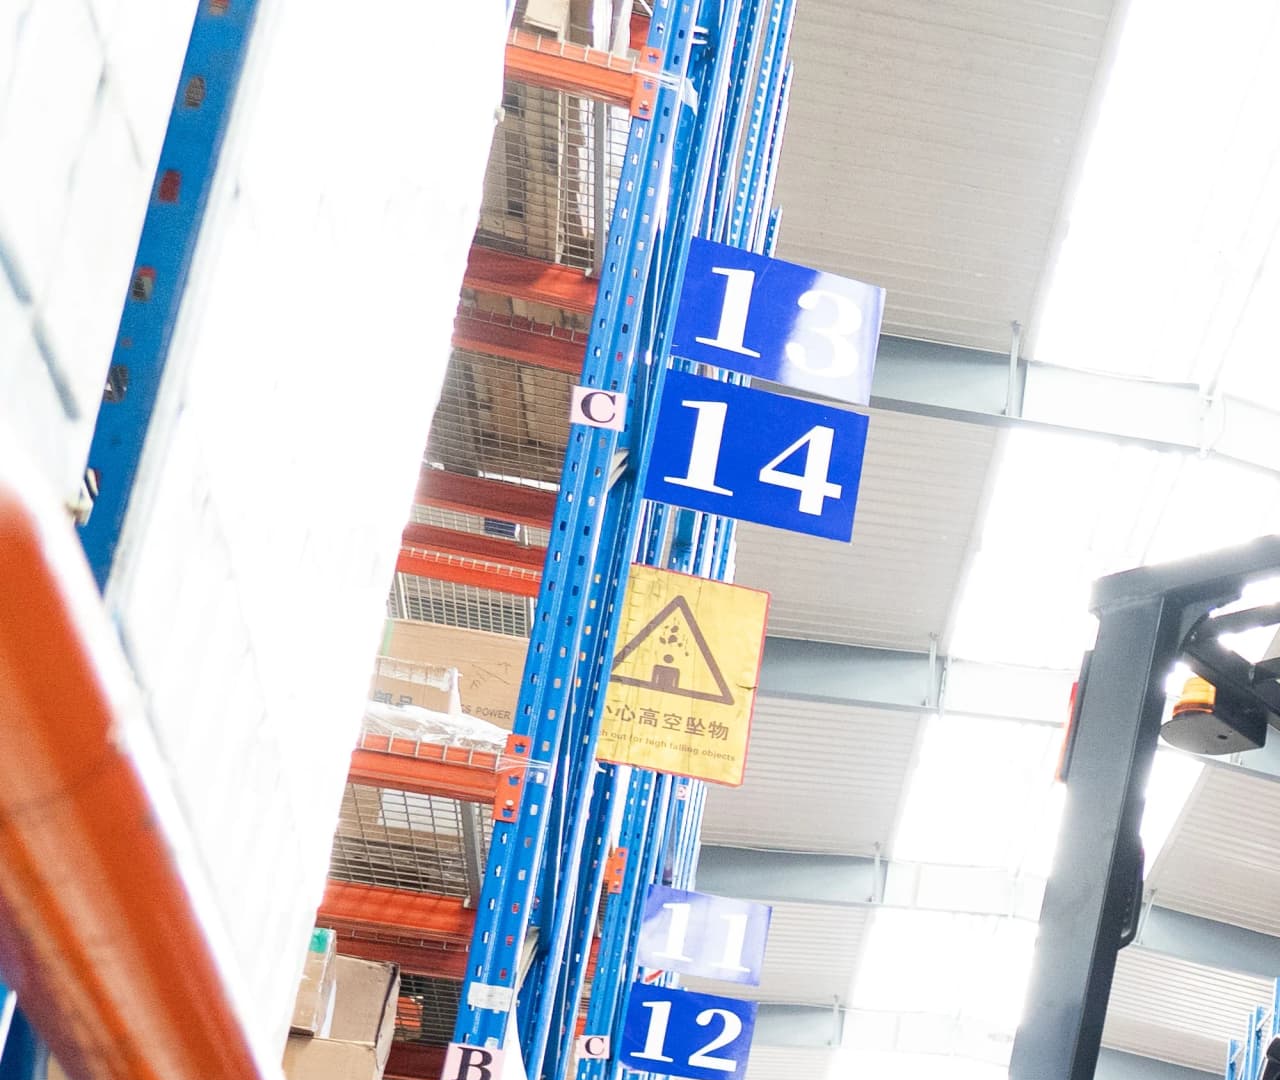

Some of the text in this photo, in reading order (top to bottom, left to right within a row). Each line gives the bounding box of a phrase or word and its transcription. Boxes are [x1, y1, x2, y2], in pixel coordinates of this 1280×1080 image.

[695, 266, 863, 378] 13
[581, 391, 616, 423] C
[664, 400, 842, 516] 14
[702, 750, 736, 762] objects
[651, 903, 750, 972] 11
[585, 1036, 605, 1056] C
[631, 1000, 742, 1072] 12
